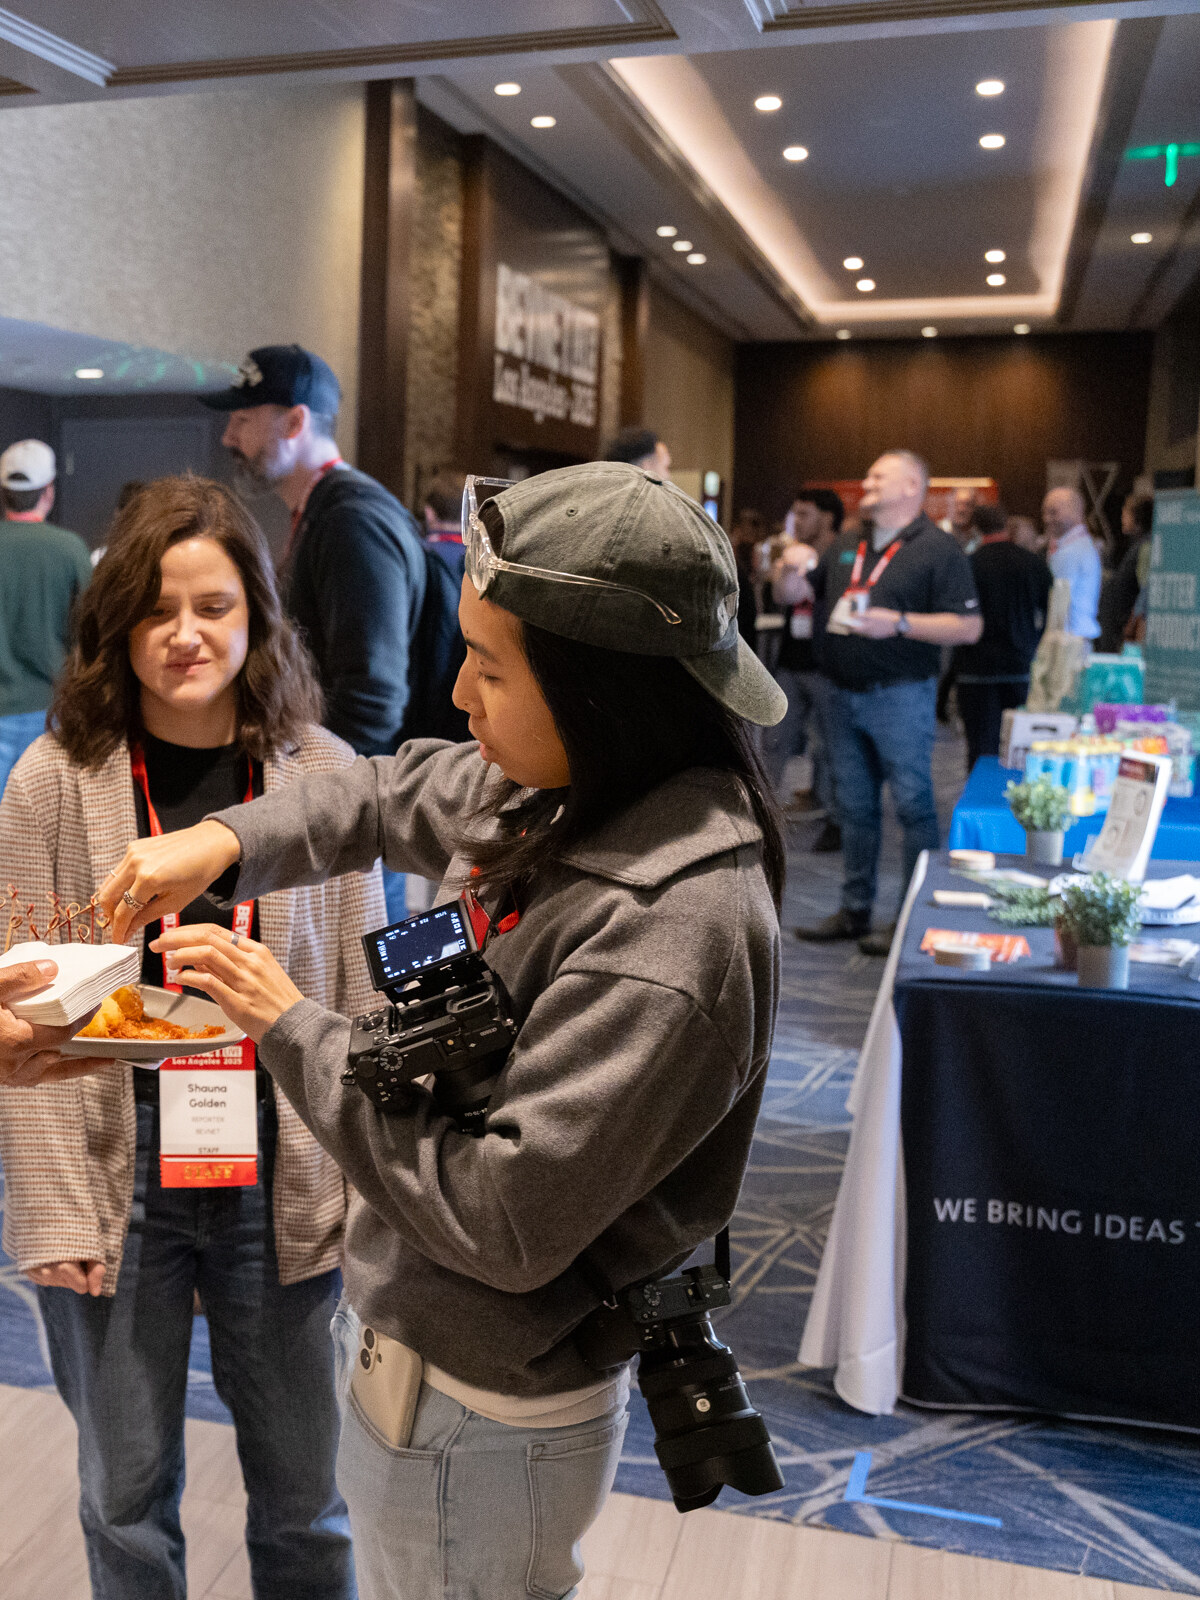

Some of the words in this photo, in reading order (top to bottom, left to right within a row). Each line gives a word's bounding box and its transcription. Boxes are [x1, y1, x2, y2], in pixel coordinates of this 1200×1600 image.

[188, 1058, 221, 1066] Angeles
[187, 1084, 227, 1093] Shauna
[189, 1099, 226, 1108] Golden
[183, 1164, 234, 1180] STAFF
[933, 1198, 977, 1223] WE
[987, 1199, 1082, 1235] BRING
[1094, 1212, 1186, 1245] IDEAS
